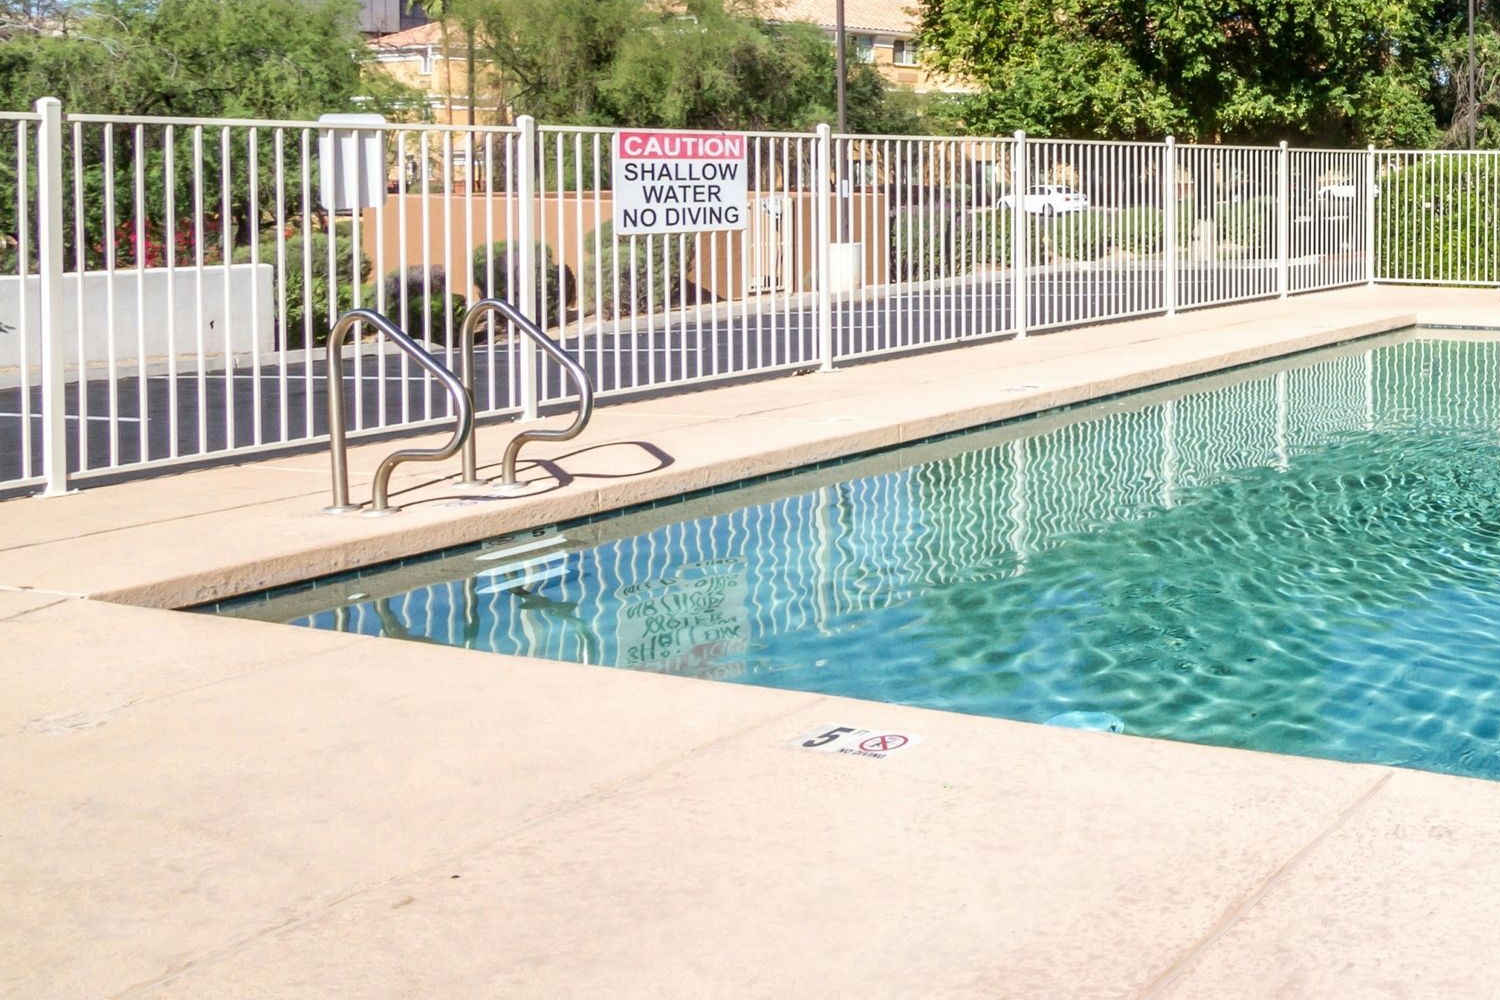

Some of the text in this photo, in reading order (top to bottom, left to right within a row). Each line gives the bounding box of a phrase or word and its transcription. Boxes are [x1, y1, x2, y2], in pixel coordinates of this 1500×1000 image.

[624, 136, 740, 157] CAUTION
[624, 163, 738, 181] SHALLOW
[642, 185, 722, 204] WATER
[623, 206, 739, 228] NO DIVING
[802, 727, 856, 747] 5
